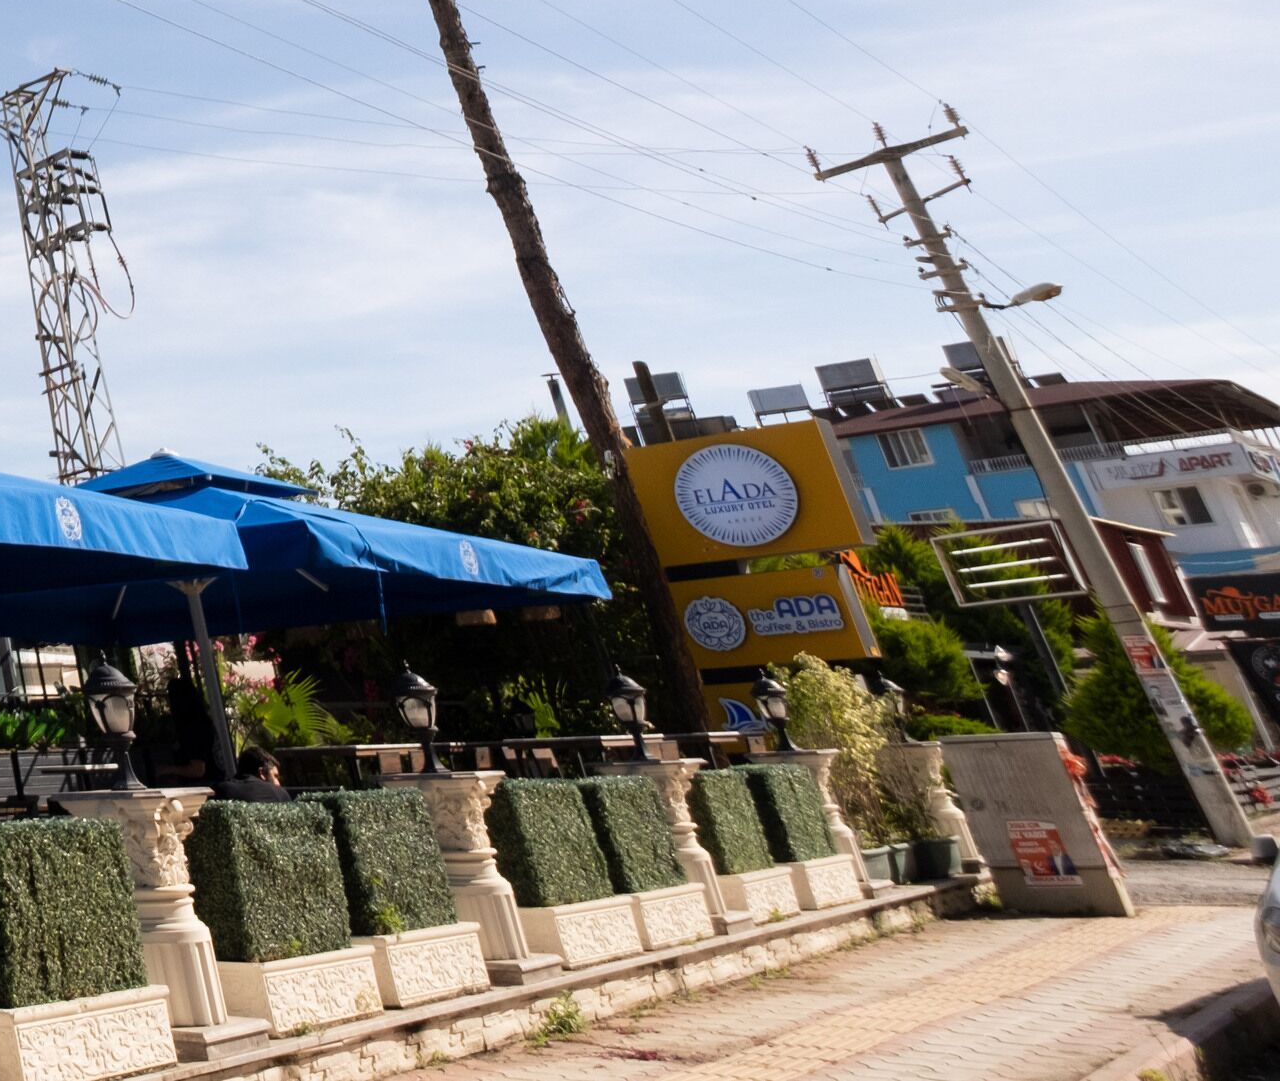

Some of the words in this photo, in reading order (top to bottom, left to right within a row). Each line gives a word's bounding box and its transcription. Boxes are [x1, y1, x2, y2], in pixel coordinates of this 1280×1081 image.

[1178, 452, 1233, 472] APART
[704, 502, 745, 515] LUXURY
[747, 499, 775, 510] OTEL
[750, 610, 775, 621] the
[775, 595, 837, 618] ADA
[703, 621, 729, 631] ADA
[754, 622, 792, 633] Coffee
[796, 621, 806, 631] &
[808, 618, 842, 629] Bistro
